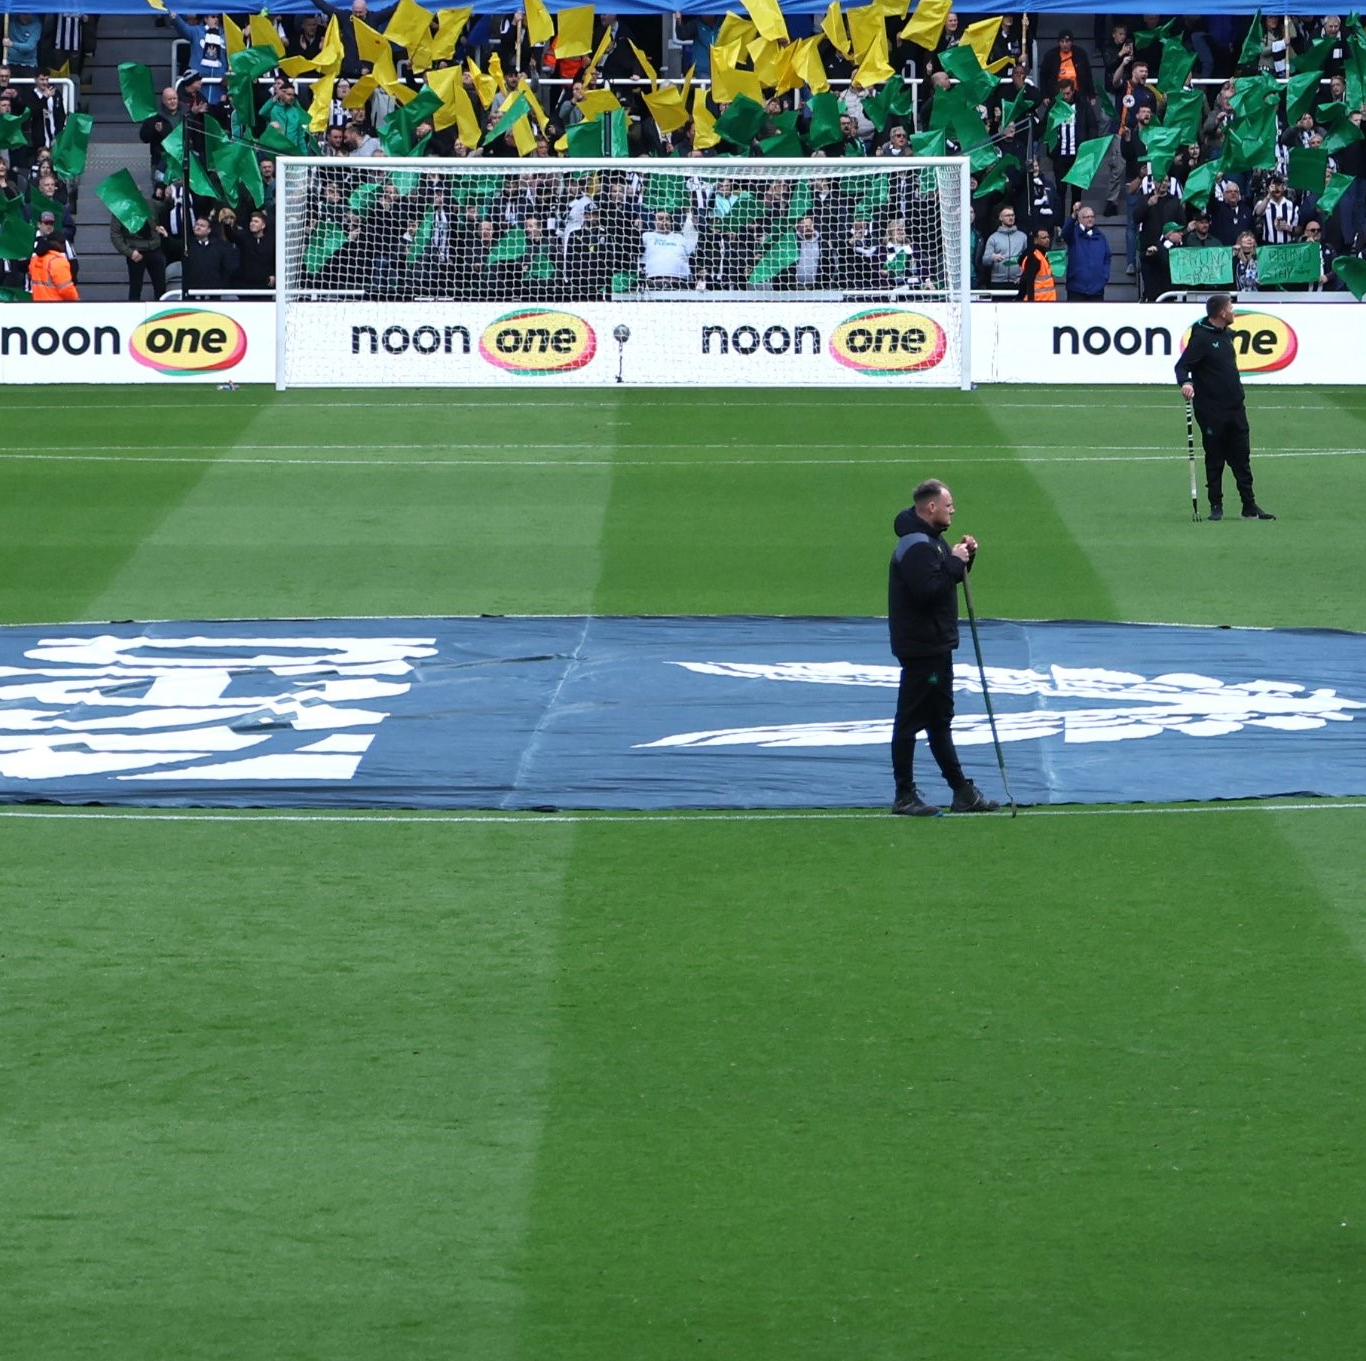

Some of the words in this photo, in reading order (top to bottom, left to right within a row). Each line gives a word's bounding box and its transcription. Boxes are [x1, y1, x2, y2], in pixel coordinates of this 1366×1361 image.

[1, 326, 120, 356] noon
[146, 328, 227, 355] one
[351, 325, 471, 355] noon
[495, 327, 577, 355] one
[701, 325, 821, 355] noon
[845, 327, 927, 355] one
[1053, 326, 1172, 356] noon
[1232, 328, 1278, 356] ne
